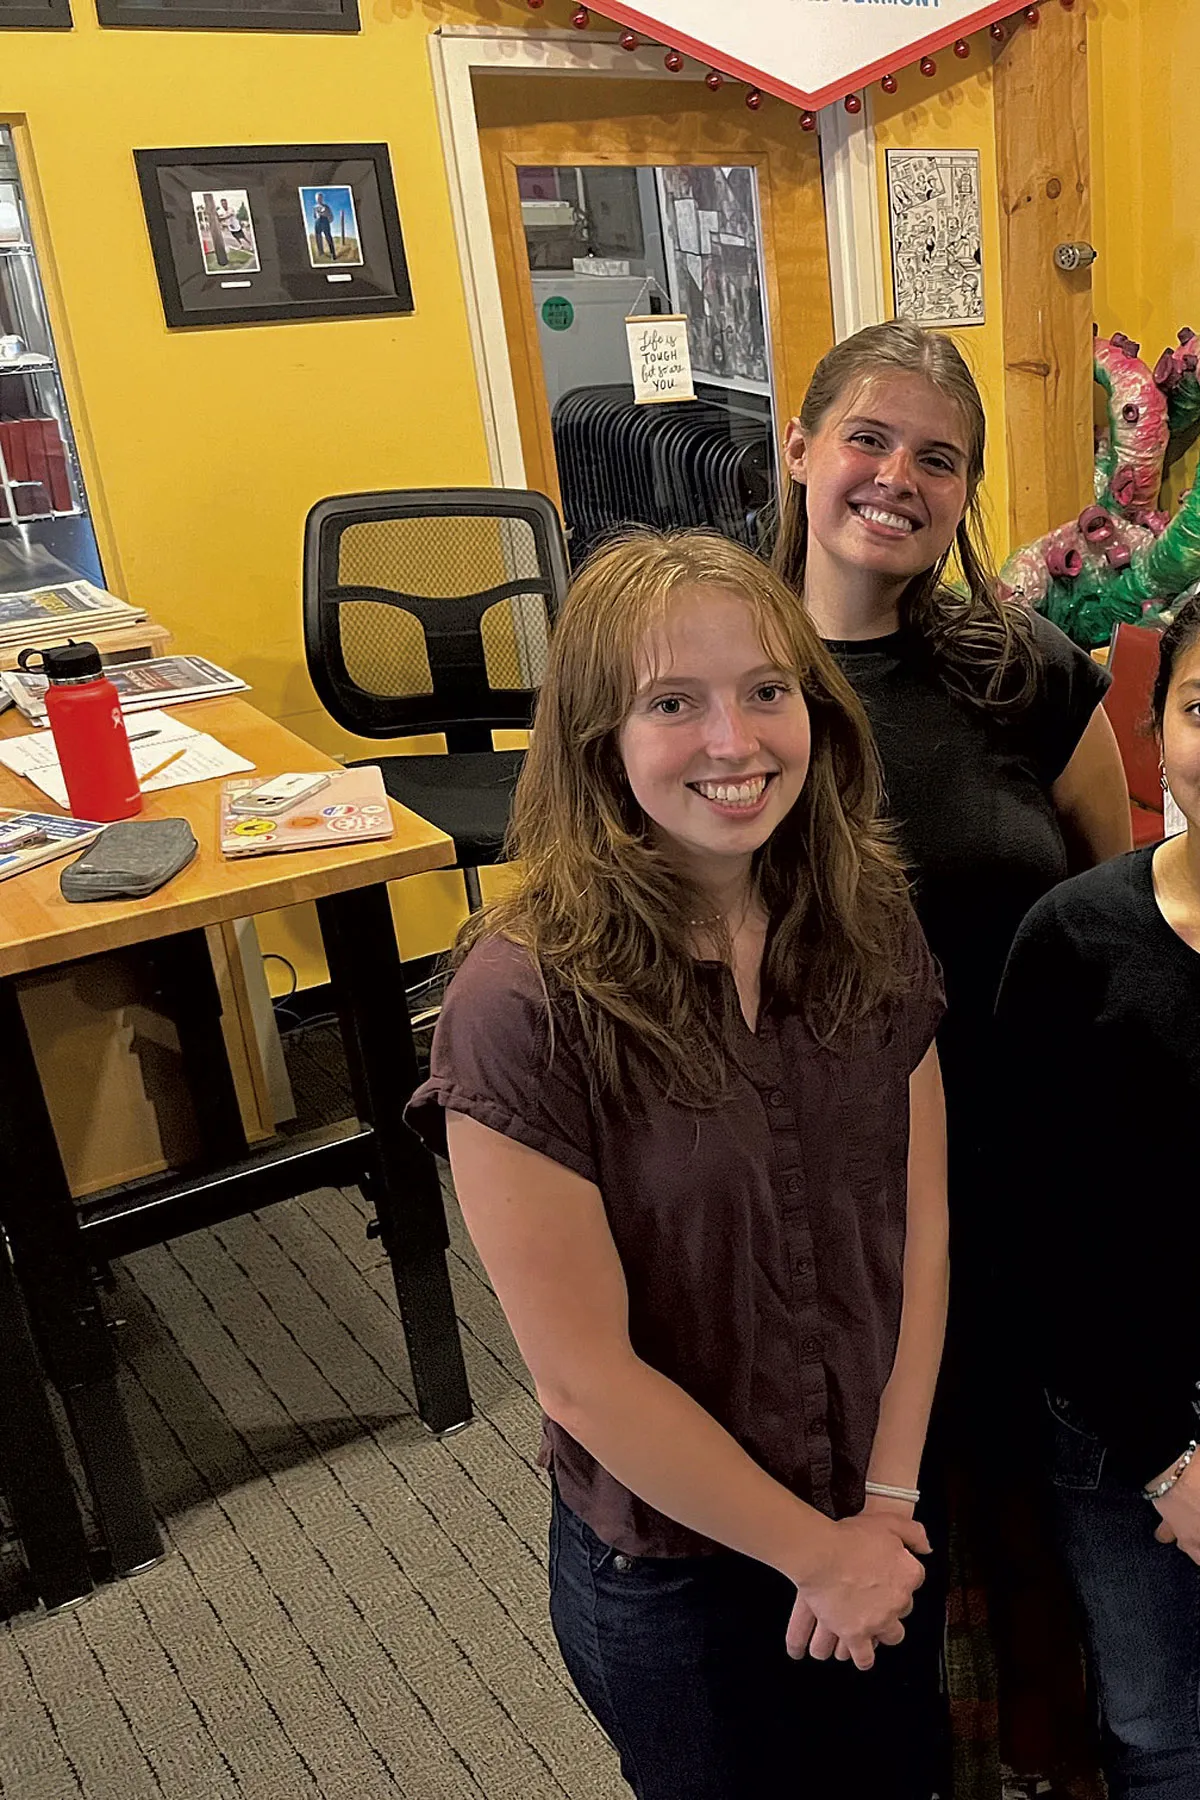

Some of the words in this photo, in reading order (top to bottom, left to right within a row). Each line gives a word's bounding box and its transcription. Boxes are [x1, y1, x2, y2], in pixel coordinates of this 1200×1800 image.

[638, 329, 664, 352] Life
[665, 335, 678, 348] is
[641, 349, 678, 365] TOUGH
[652, 377, 676, 392] YOU
